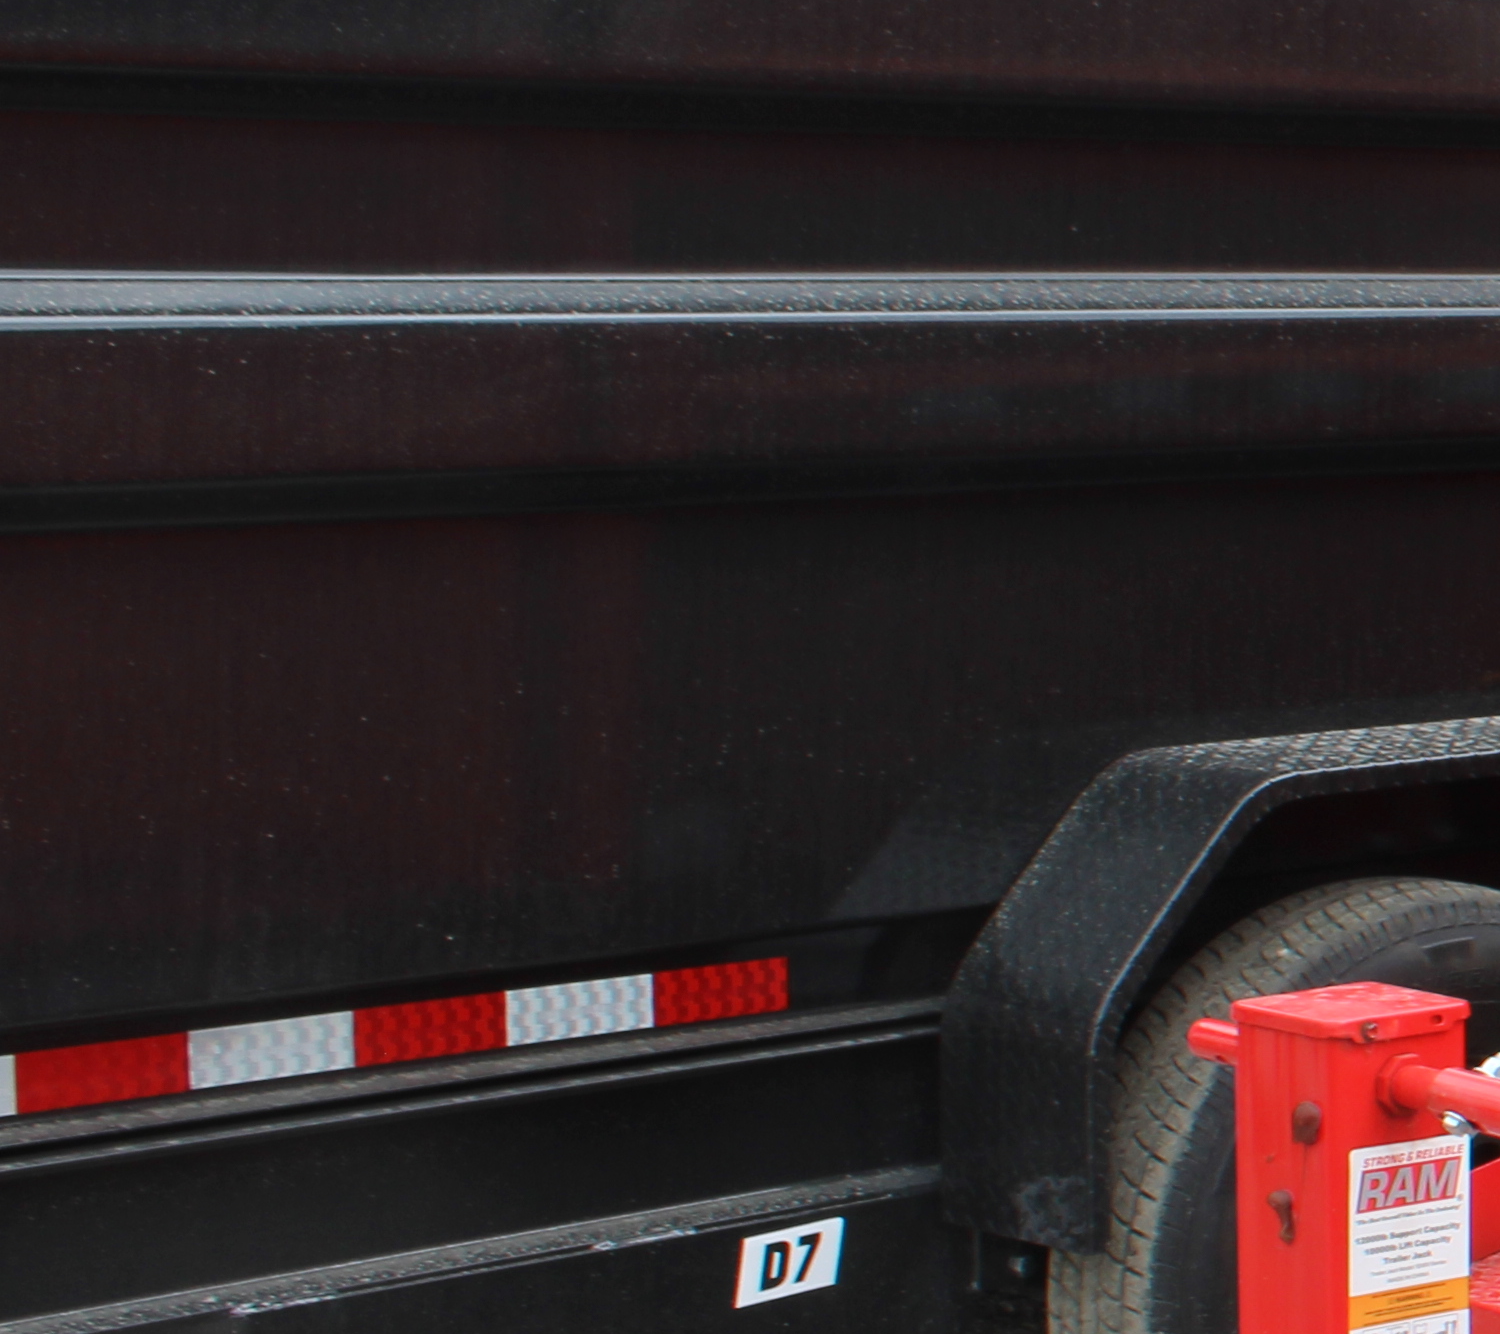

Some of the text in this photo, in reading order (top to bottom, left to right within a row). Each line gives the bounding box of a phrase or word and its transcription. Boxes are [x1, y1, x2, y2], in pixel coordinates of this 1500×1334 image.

[1363, 1153, 1405, 1168] STRONG
[1415, 1144, 1464, 1159] RELIABLE
[1358, 1159, 1459, 1211] RAM
[759, 1232, 823, 1292] D7
